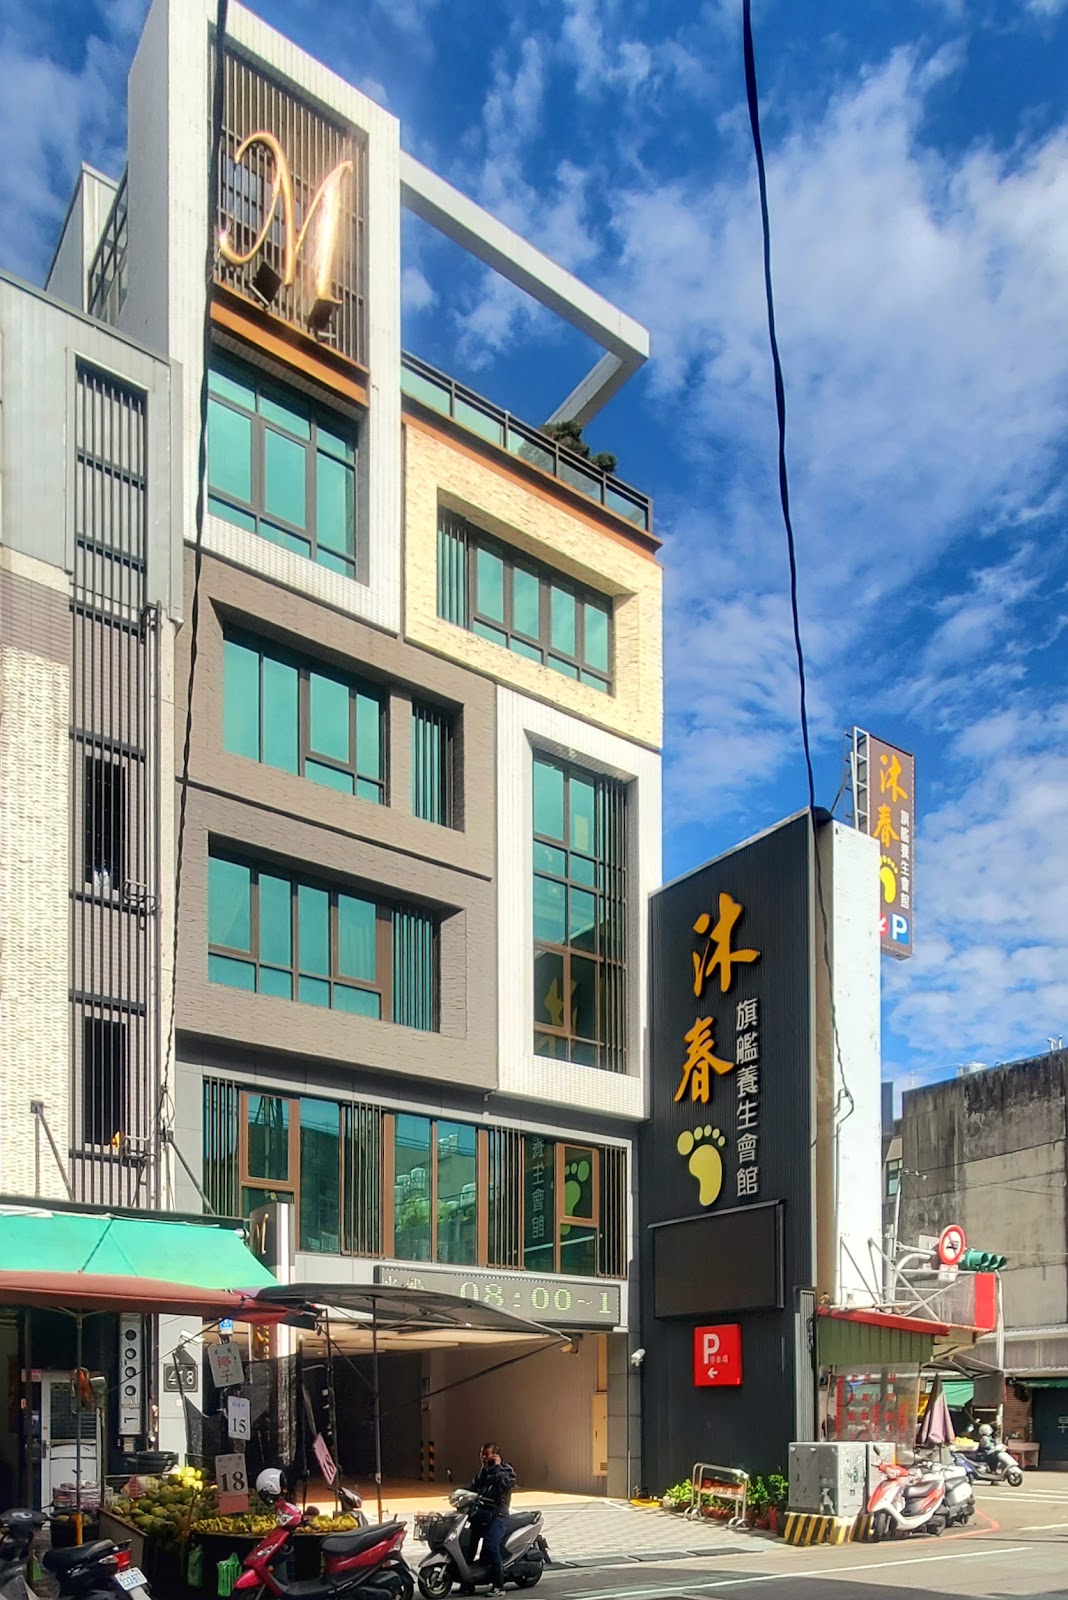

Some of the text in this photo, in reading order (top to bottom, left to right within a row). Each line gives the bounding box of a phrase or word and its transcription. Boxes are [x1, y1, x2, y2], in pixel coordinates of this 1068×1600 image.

[873, 754, 908, 848] 沐春
[891, 914, 908, 940] P
[673, 891, 760, 1104] 沐春
[736, 998, 759, 1197] 旗艦養生會館
[703, 1333, 720, 1365] P
[168, 1370, 194, 1385] 418
[233, 1417, 246, 1434] 15
[219, 1471, 245, 1492] 18
